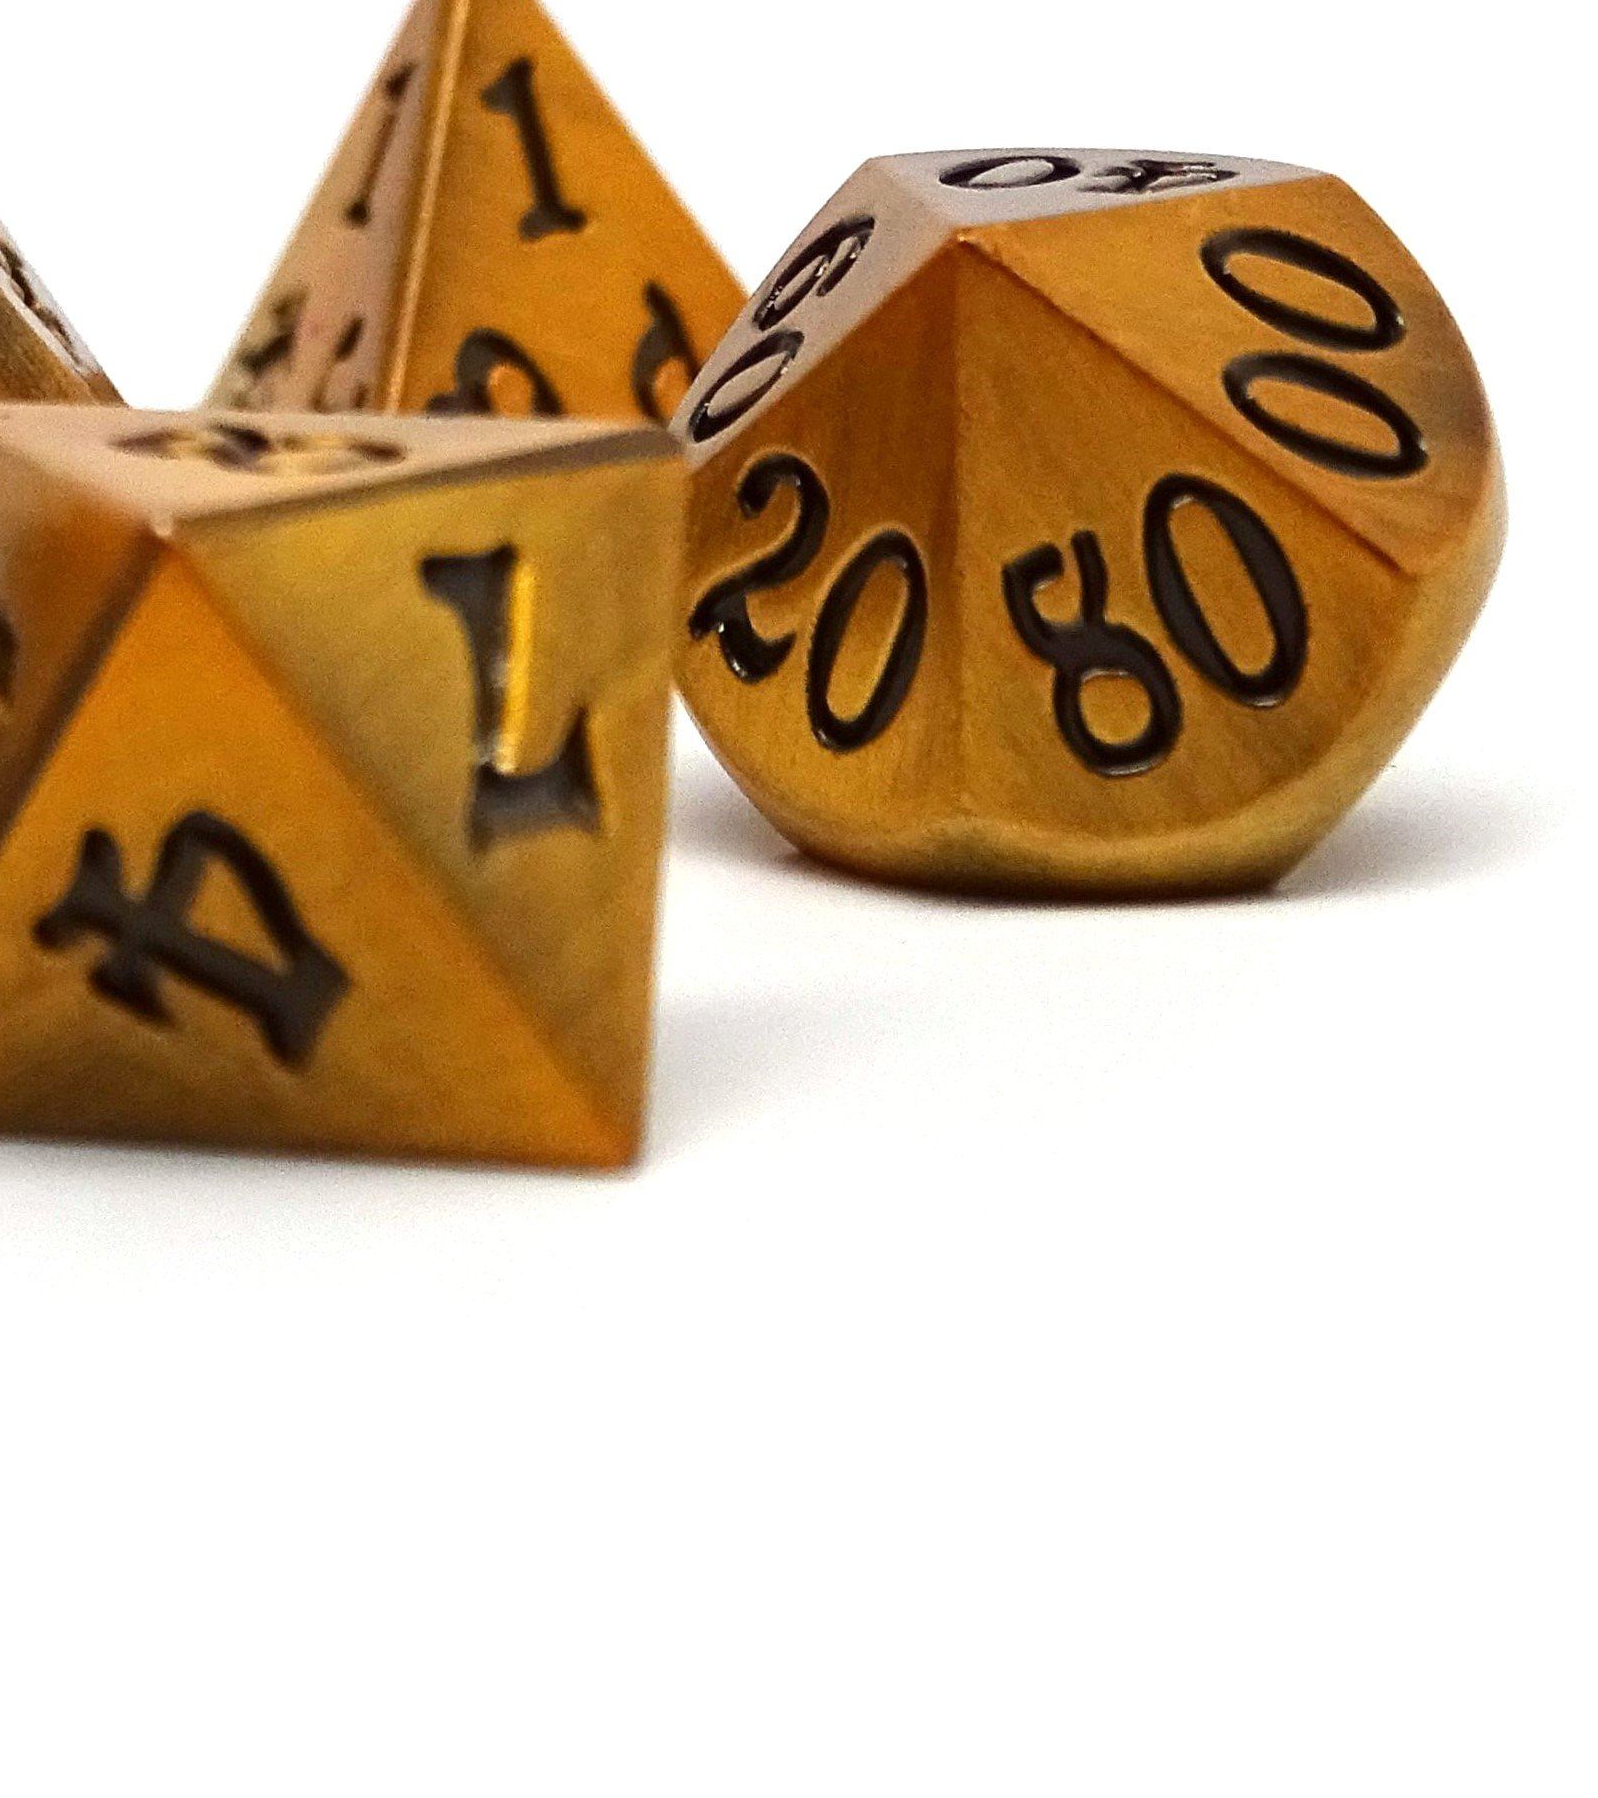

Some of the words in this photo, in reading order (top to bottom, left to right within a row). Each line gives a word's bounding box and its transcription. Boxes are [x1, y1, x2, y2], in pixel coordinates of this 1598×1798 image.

[480, 56, 588, 243] 1
[938, 154, 1240, 195] 40
[1200, 227, 1428, 479] 00
[419, 542, 617, 858] 1
[689, 452, 929, 752] 20
[1003, 472, 1309, 778] 80
[32, 809, 352, 1074] 4
